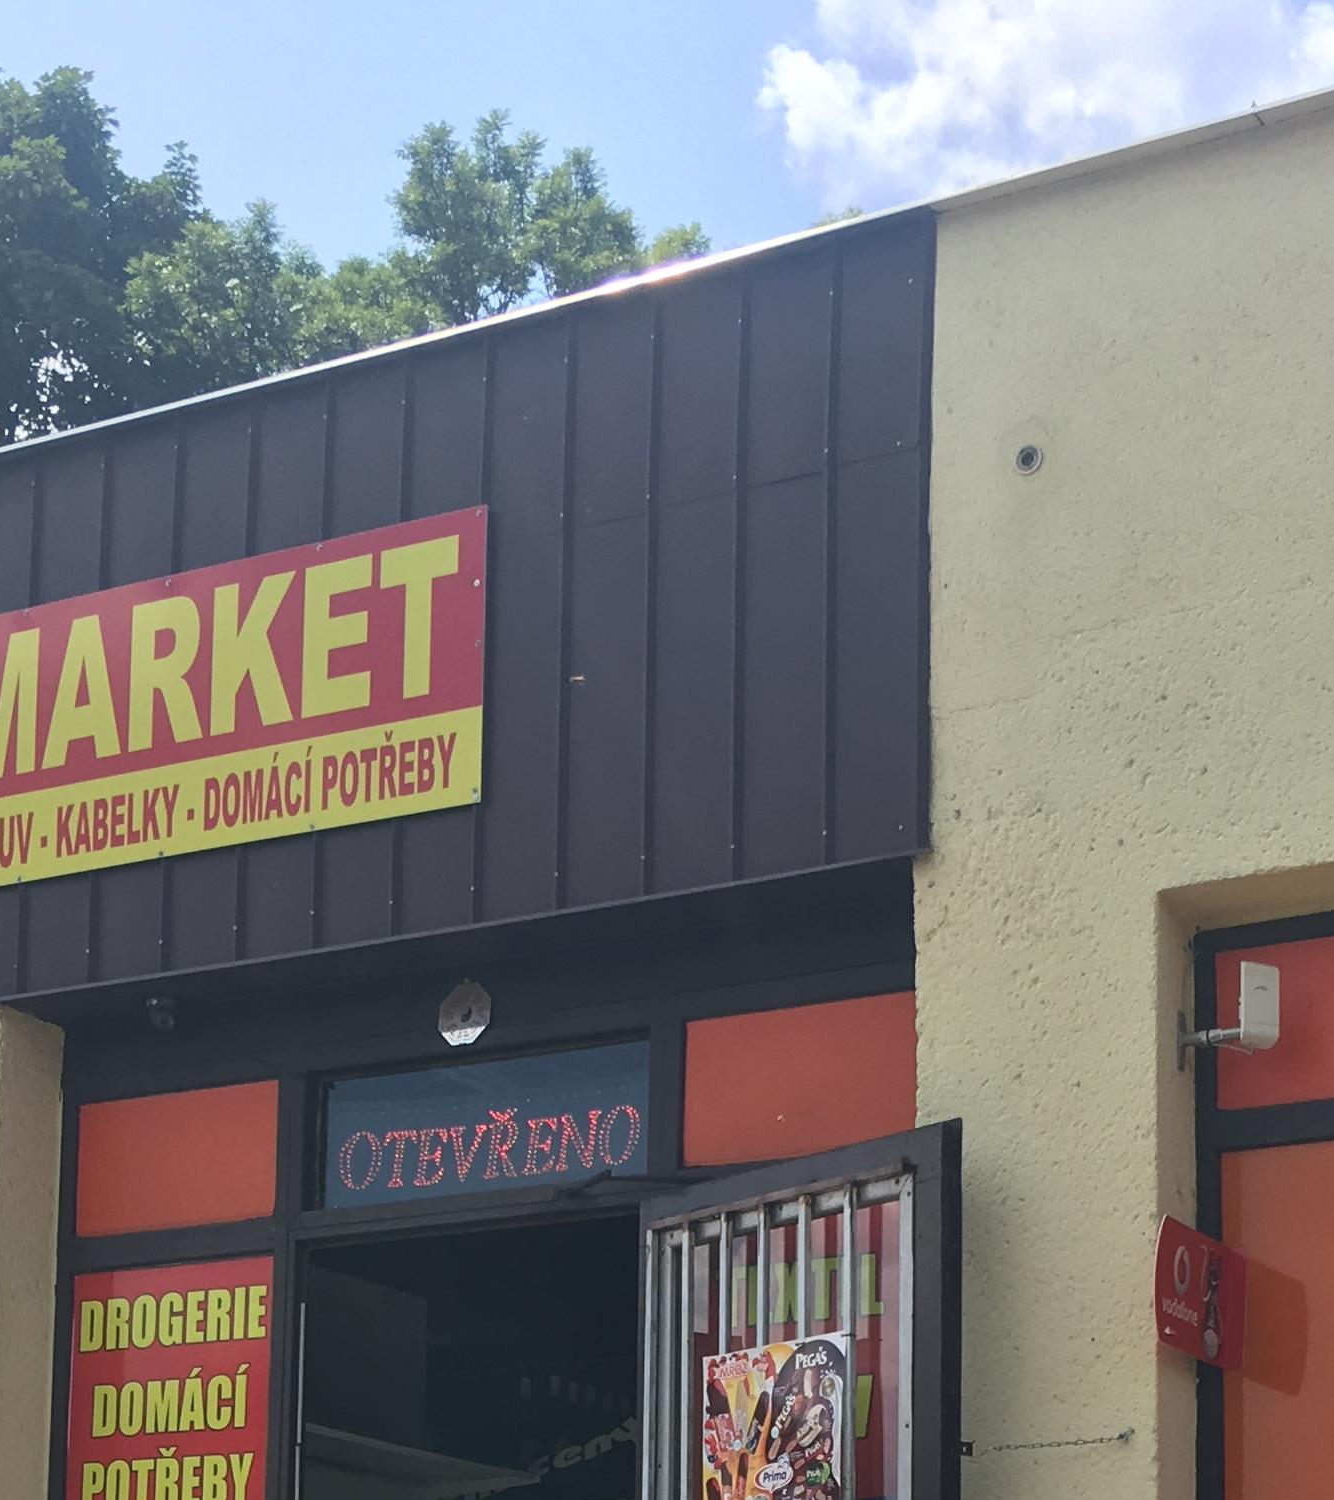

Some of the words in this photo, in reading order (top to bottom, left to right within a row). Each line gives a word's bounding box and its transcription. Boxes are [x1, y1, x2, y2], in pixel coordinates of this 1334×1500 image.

[55, 783, 179, 859] KABELKY
[203, 744, 313, 832] DOMÁCÍ
[322, 730, 458, 812] POTŘEBY
[338, 1104, 642, 1191] OTEVŘENO
[79, 1284, 268, 1353] DROGERIE
[1162, 1297, 1199, 1327] vodafone
[91, 1363, 251, 1438] DOMÁCÍ
[762, 1469, 787, 1484] Prima
